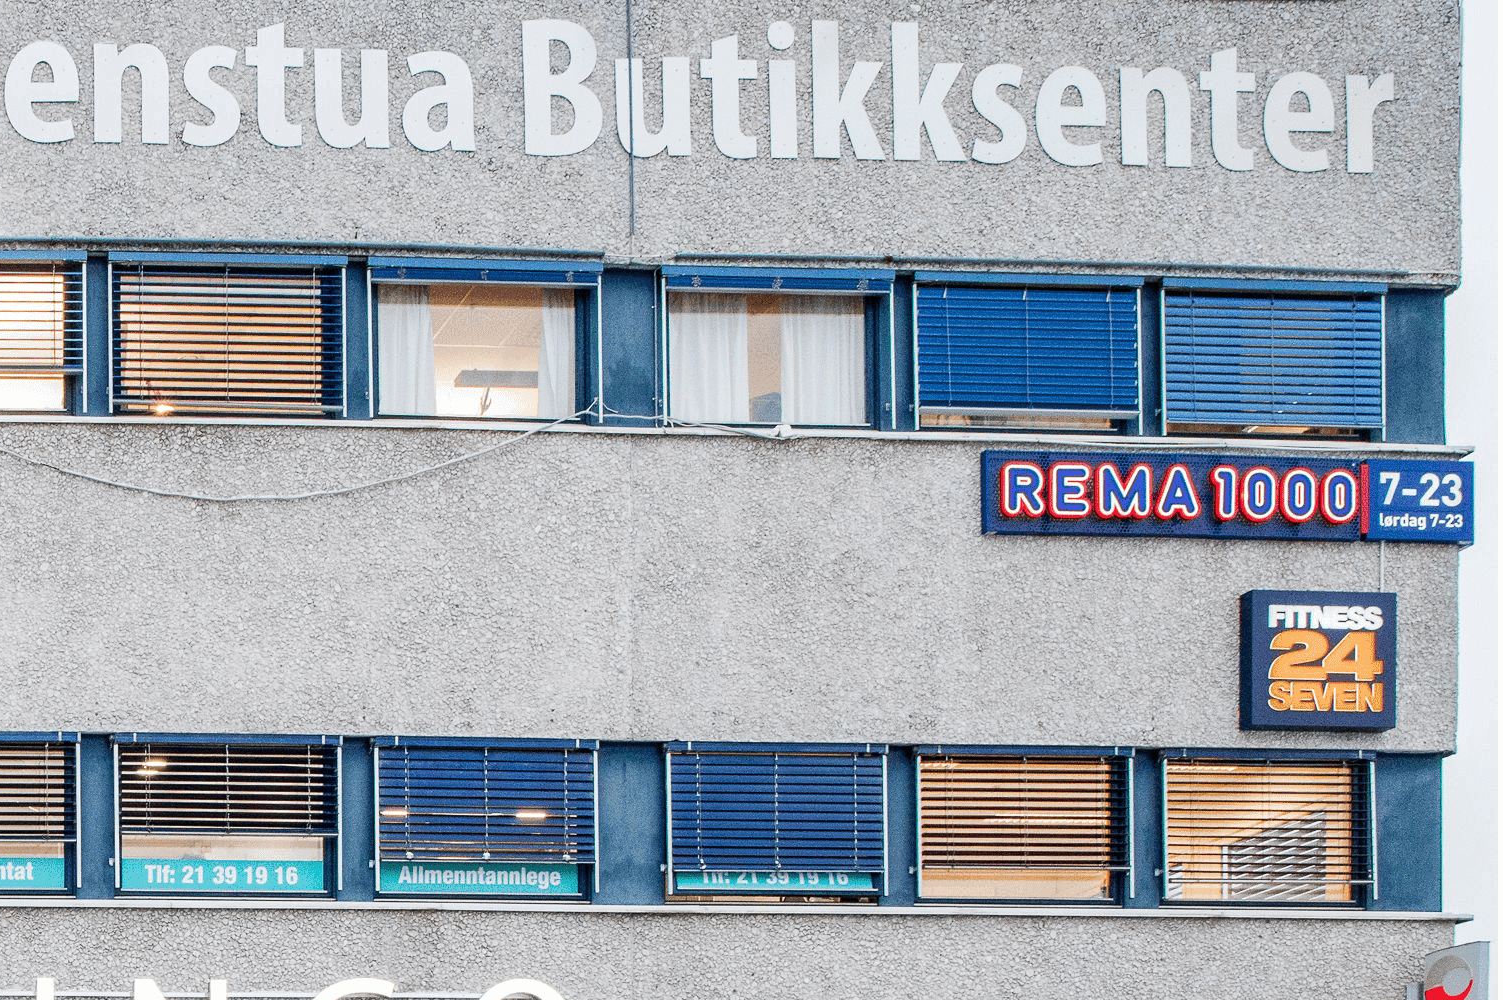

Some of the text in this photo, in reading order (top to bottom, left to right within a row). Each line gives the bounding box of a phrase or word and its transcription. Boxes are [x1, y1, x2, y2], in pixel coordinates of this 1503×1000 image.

[521, 18, 1396, 174] Butikksenter
[1000, 460, 1359, 524] REMA 1000
[1379, 471, 1463, 507] 7-23
[1379, 512, 1464, 530] lørdag 7-23
[1267, 604, 1384, 631] FITNESS
[1268, 629, 1384, 681] 24
[1267, 680, 1384, 713] SEVEN
[144, 864, 299, 885] Tlf: 21 39 19 16
[398, 866, 561, 889] Allmenntannlege
